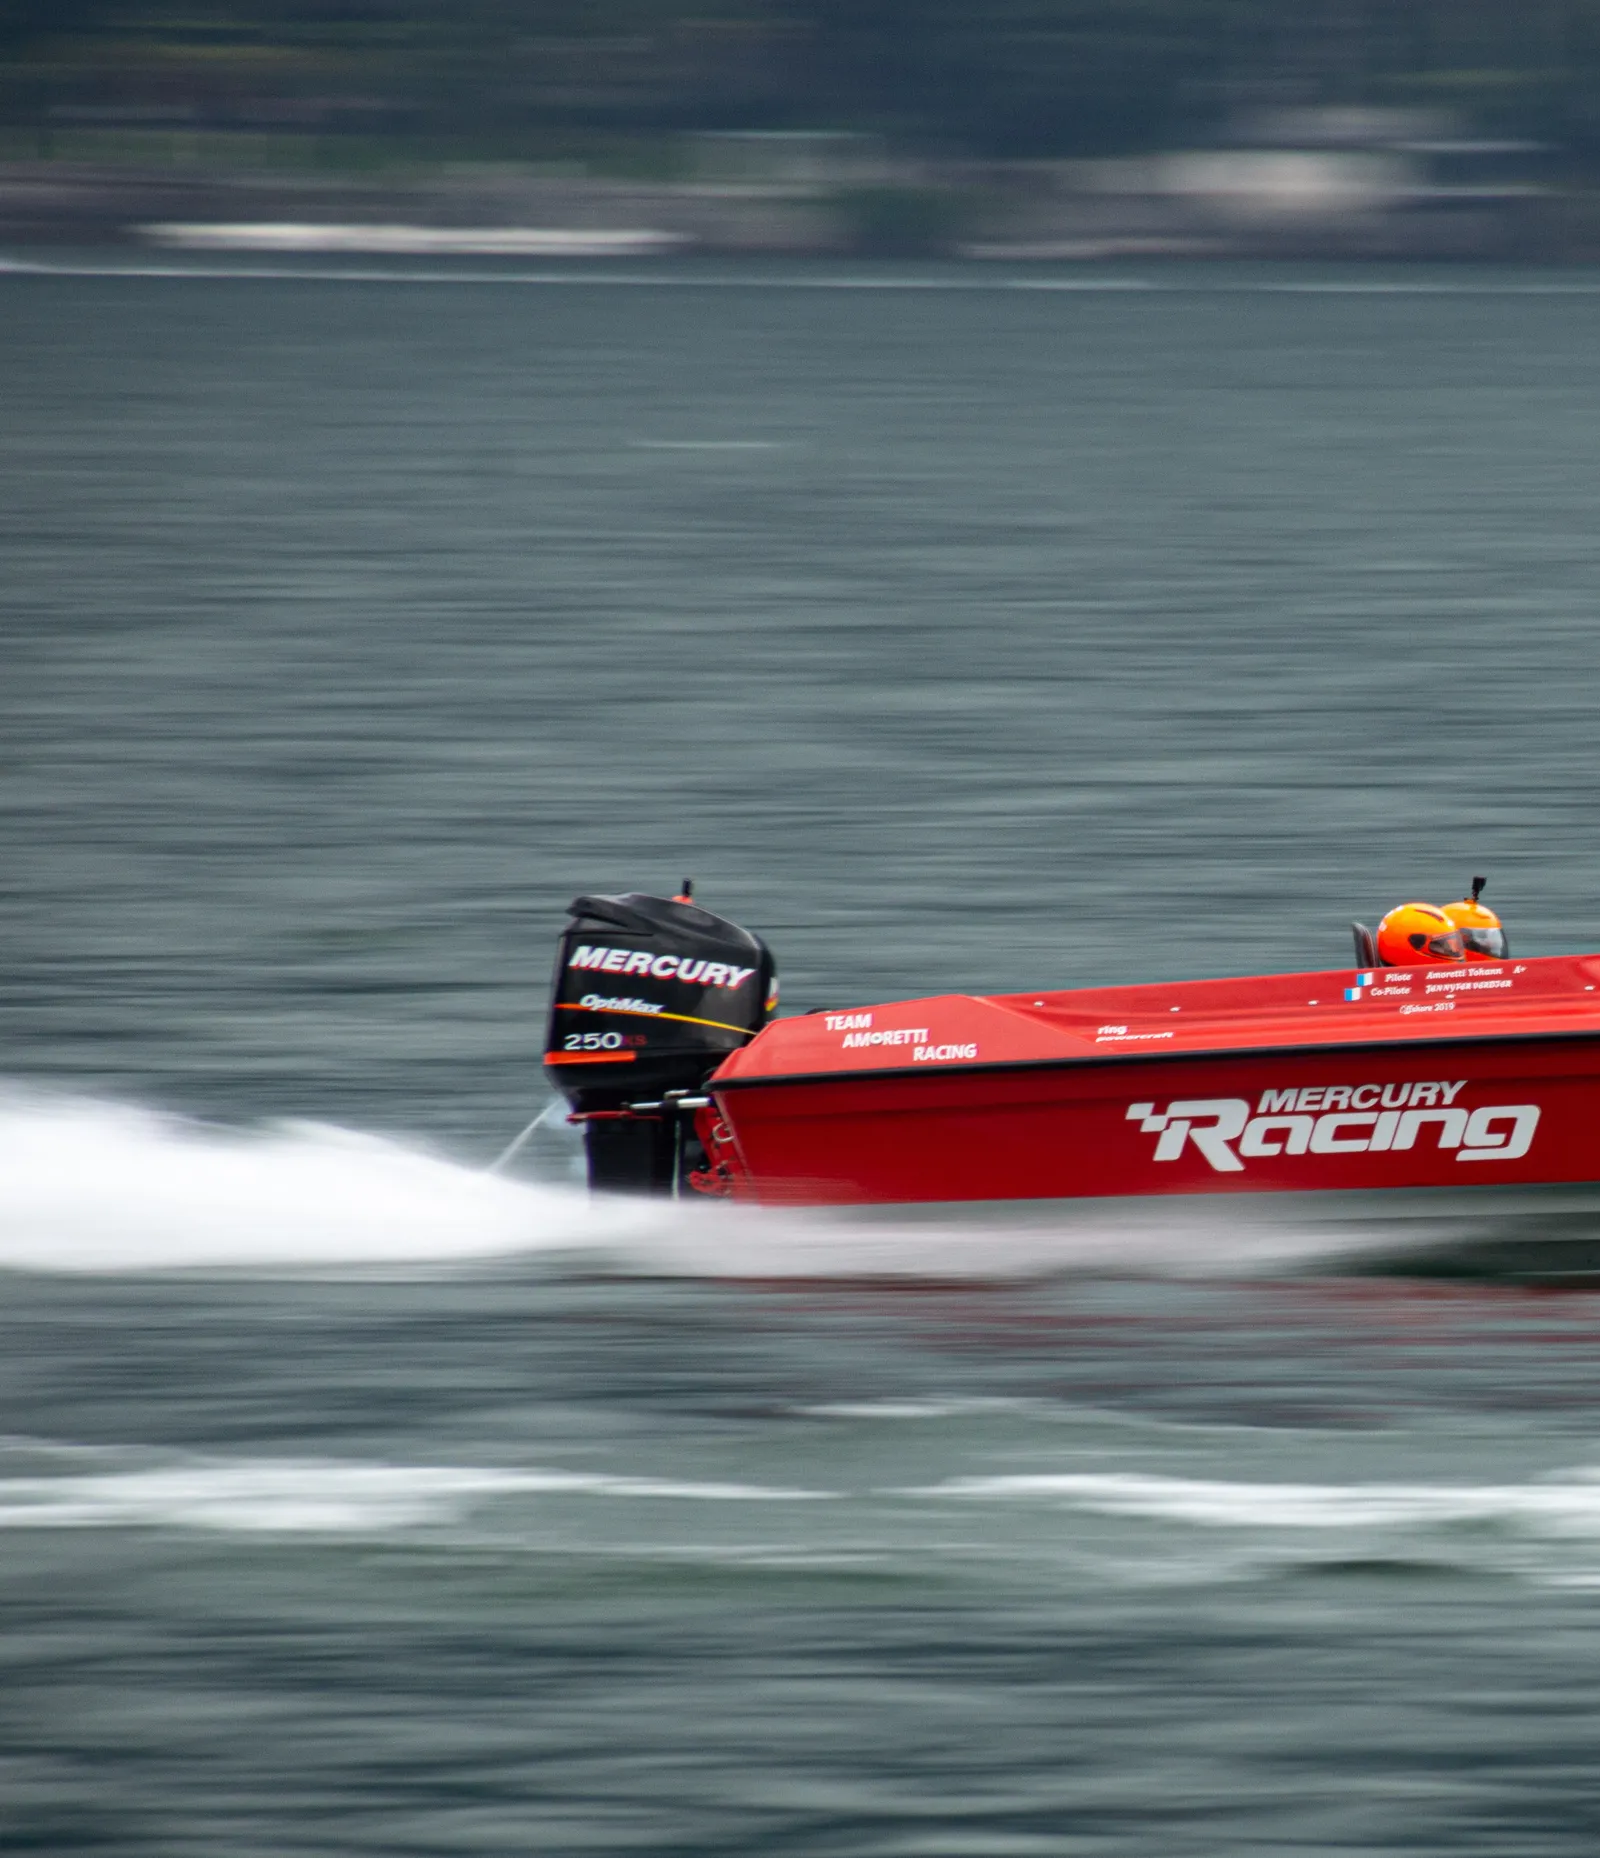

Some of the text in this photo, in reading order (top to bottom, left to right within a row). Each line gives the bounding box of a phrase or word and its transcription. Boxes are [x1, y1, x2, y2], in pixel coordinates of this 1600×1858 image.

[569, 946, 756, 990] MERCURY
[1385, 973, 1411, 982] Pilote
[1426, 968, 1467, 980] Amoretti
[1468, 967, 1504, 977] Yohann
[579, 994, 664, 1014] OptiMax
[1434, 1001, 1456, 1012] 2019
[825, 1013, 873, 1031] TEAM
[1097, 1025, 1128, 1036] ring
[842, 1028, 929, 1048] AMORETTI
[913, 1044, 978, 1062] RACING
[1257, 1080, 1468, 1114] MERCURY
[1126, 1098, 1541, 1172] Racing
